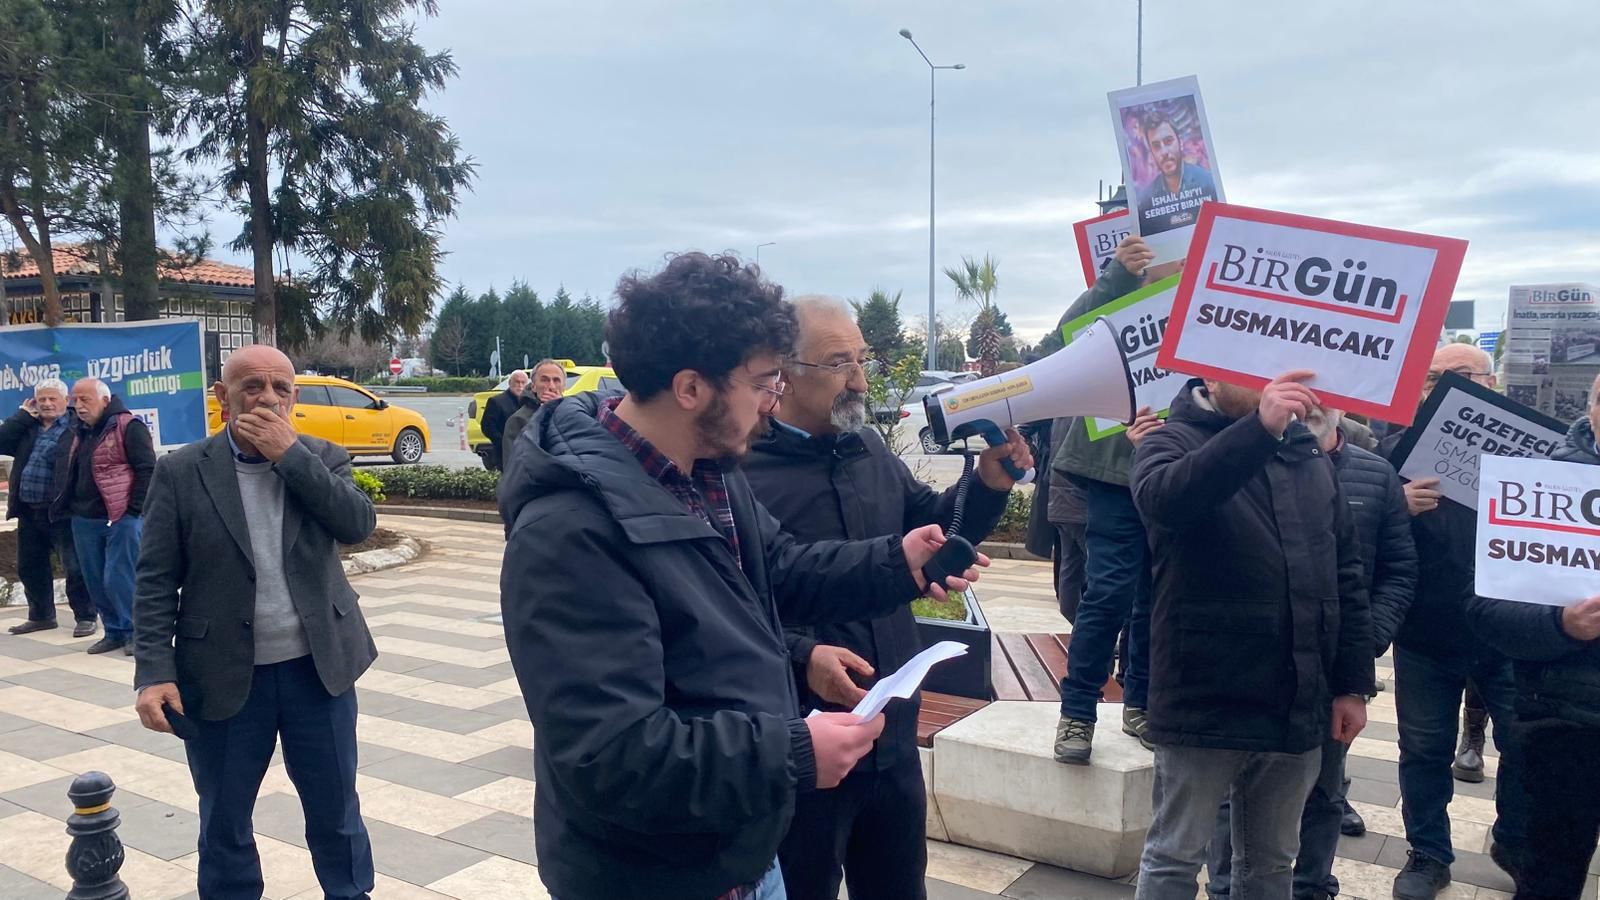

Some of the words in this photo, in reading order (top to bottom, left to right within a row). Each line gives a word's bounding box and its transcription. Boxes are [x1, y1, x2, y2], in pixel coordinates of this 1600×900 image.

[1145, 203, 1180, 219] SERBEST
[1196, 303, 1395, 361] SUSMAYACAK!
[87, 345, 173, 383] özgürlük
[131, 374, 182, 396] mitingi
[1440, 420, 1482, 447] SUÇ
[1458, 406, 1559, 457] GAZETECİ
[1433, 436, 1480, 471] İSMA
